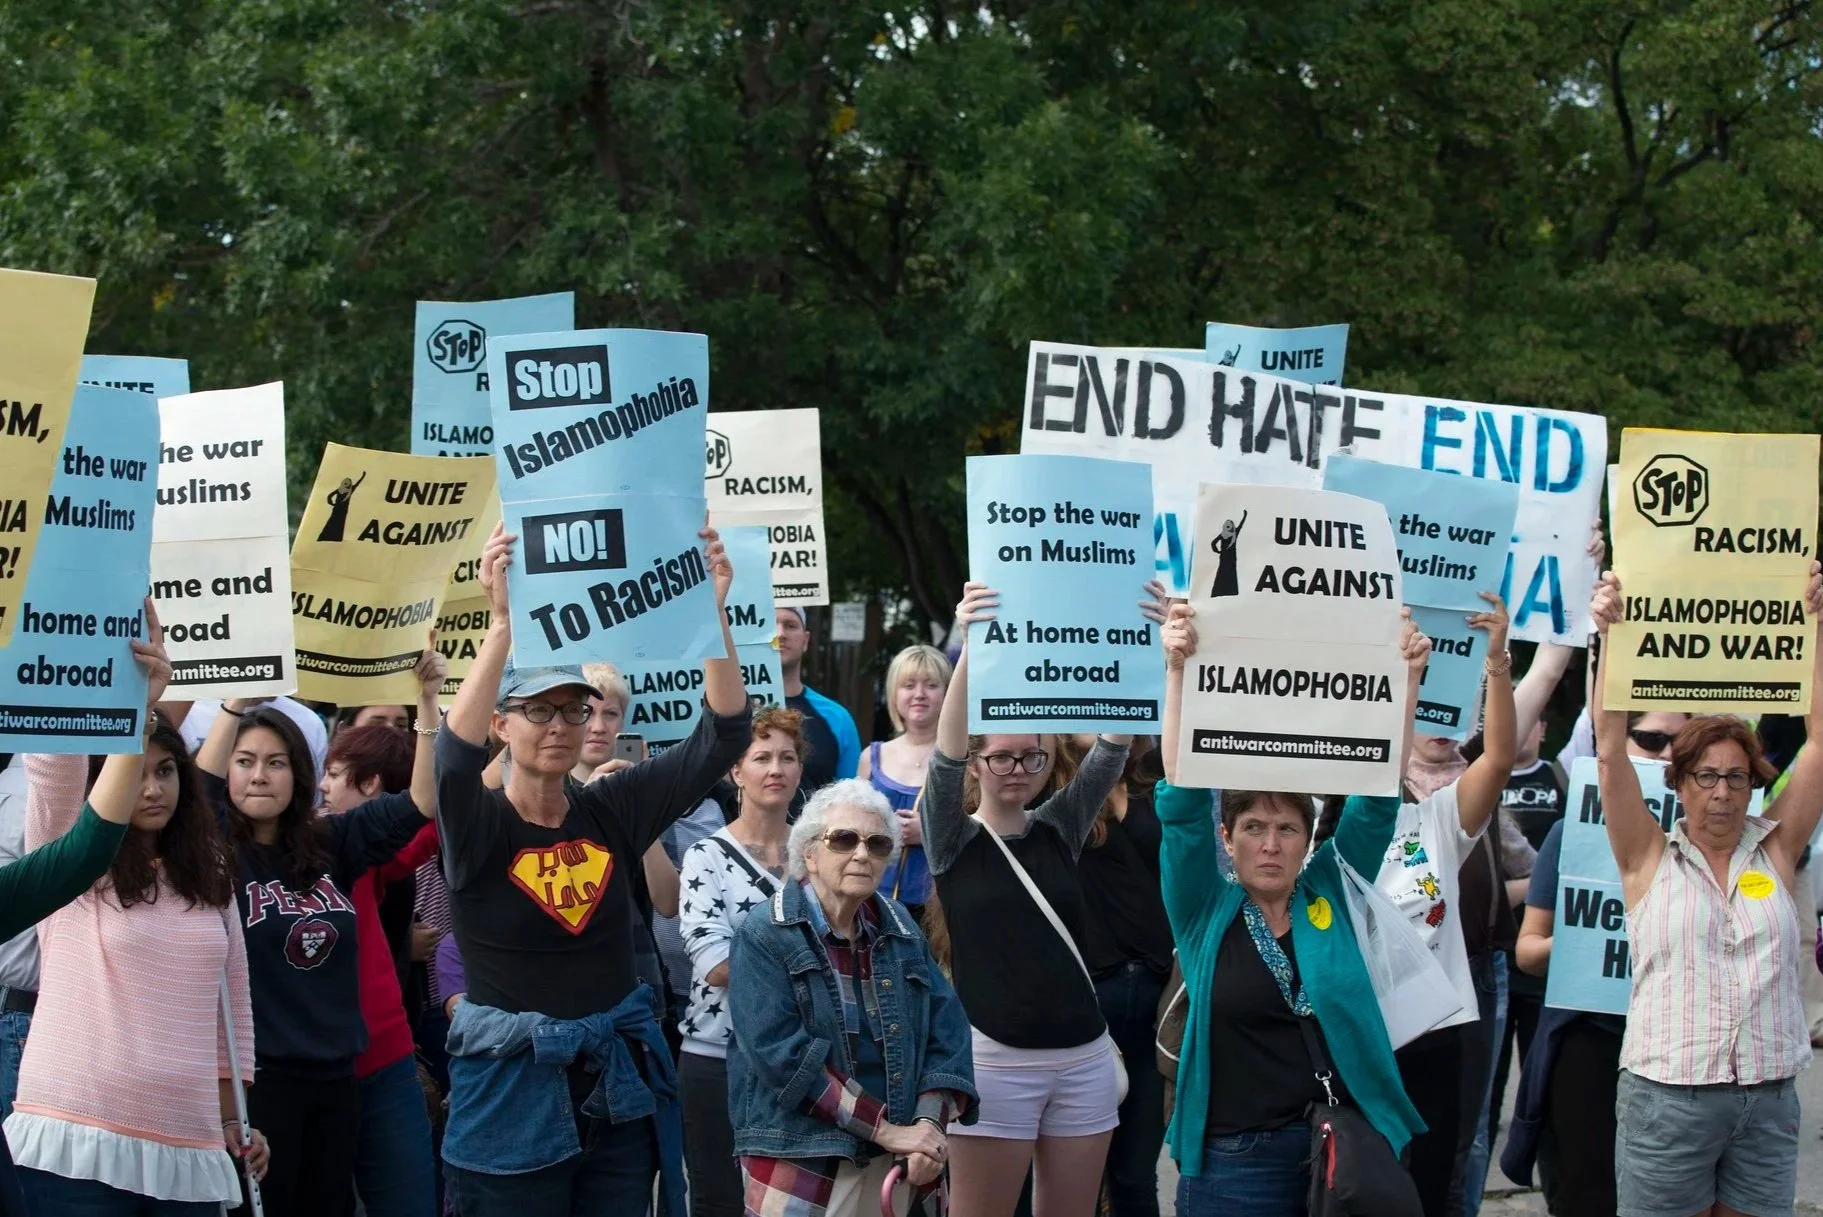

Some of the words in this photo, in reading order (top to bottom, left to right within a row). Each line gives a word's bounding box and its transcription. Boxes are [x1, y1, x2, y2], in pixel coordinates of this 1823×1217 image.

[1261, 348, 1324, 370] UNITE
[514, 359, 604, 401] Stop
[502, 375, 700, 481] Islamophobia
[1029, 352, 1187, 441] END
[1207, 370, 1386, 470] HATE
[1420, 404, 1584, 494] END
[63, 445, 105, 478] the
[110, 457, 148, 482] war
[158, 441, 193, 465] he
[203, 439, 264, 461] war
[156, 478, 252, 506] uslims
[384, 479, 468, 506] UNITE
[725, 475, 814, 497] RACISM,
[1641, 467, 1702, 517] STOP
[45, 494, 136, 532] Muslims
[987, 501, 1047, 529] Stop
[1053, 501, 1095, 525] the
[1100, 512, 1141, 529] war
[357, 517, 475, 547] AGAINST
[542, 519, 608, 564] NO!
[1274, 517, 1367, 551] UNITE
[1400, 514, 1441, 540] the
[1448, 525, 1496, 547] war
[1693, 527, 1809, 557] RACISM,
[998, 544, 1032, 563] on
[1041, 539, 1136, 566] Muslims
[1397, 549, 1478, 581] uslims
[211, 567, 273, 597] and
[1254, 565, 1395, 600] AGAINST
[529, 602, 593, 652] To
[587, 545, 707, 631] Racism
[1625, 596, 1806, 626] ISLAMOPHOBIA
[23, 602, 97, 637] home
[104, 609, 142, 638] and
[984, 620, 1018, 645] At
[1026, 620, 1099, 644] home
[1106, 624, 1152, 646] and
[1636, 632, 1711, 661] AND
[1720, 635, 1805, 661] WAR!
[17, 654, 114, 688] abroad
[295, 653, 418, 678] tiwarcommittee.org
[1024, 659, 1120, 683] abroad
[1198, 664, 1393, 703] ISLAMOPHOBIA
[1631, 683, 1801, 702] antiwarcommittee.org
[0, 710, 131, 733] tiwarcommittee.org
[631, 699, 693, 725] AND
[988, 701, 1152, 719] antiwarcommittee.org
[1199, 736, 1383, 761] antiwarcommittee.org
